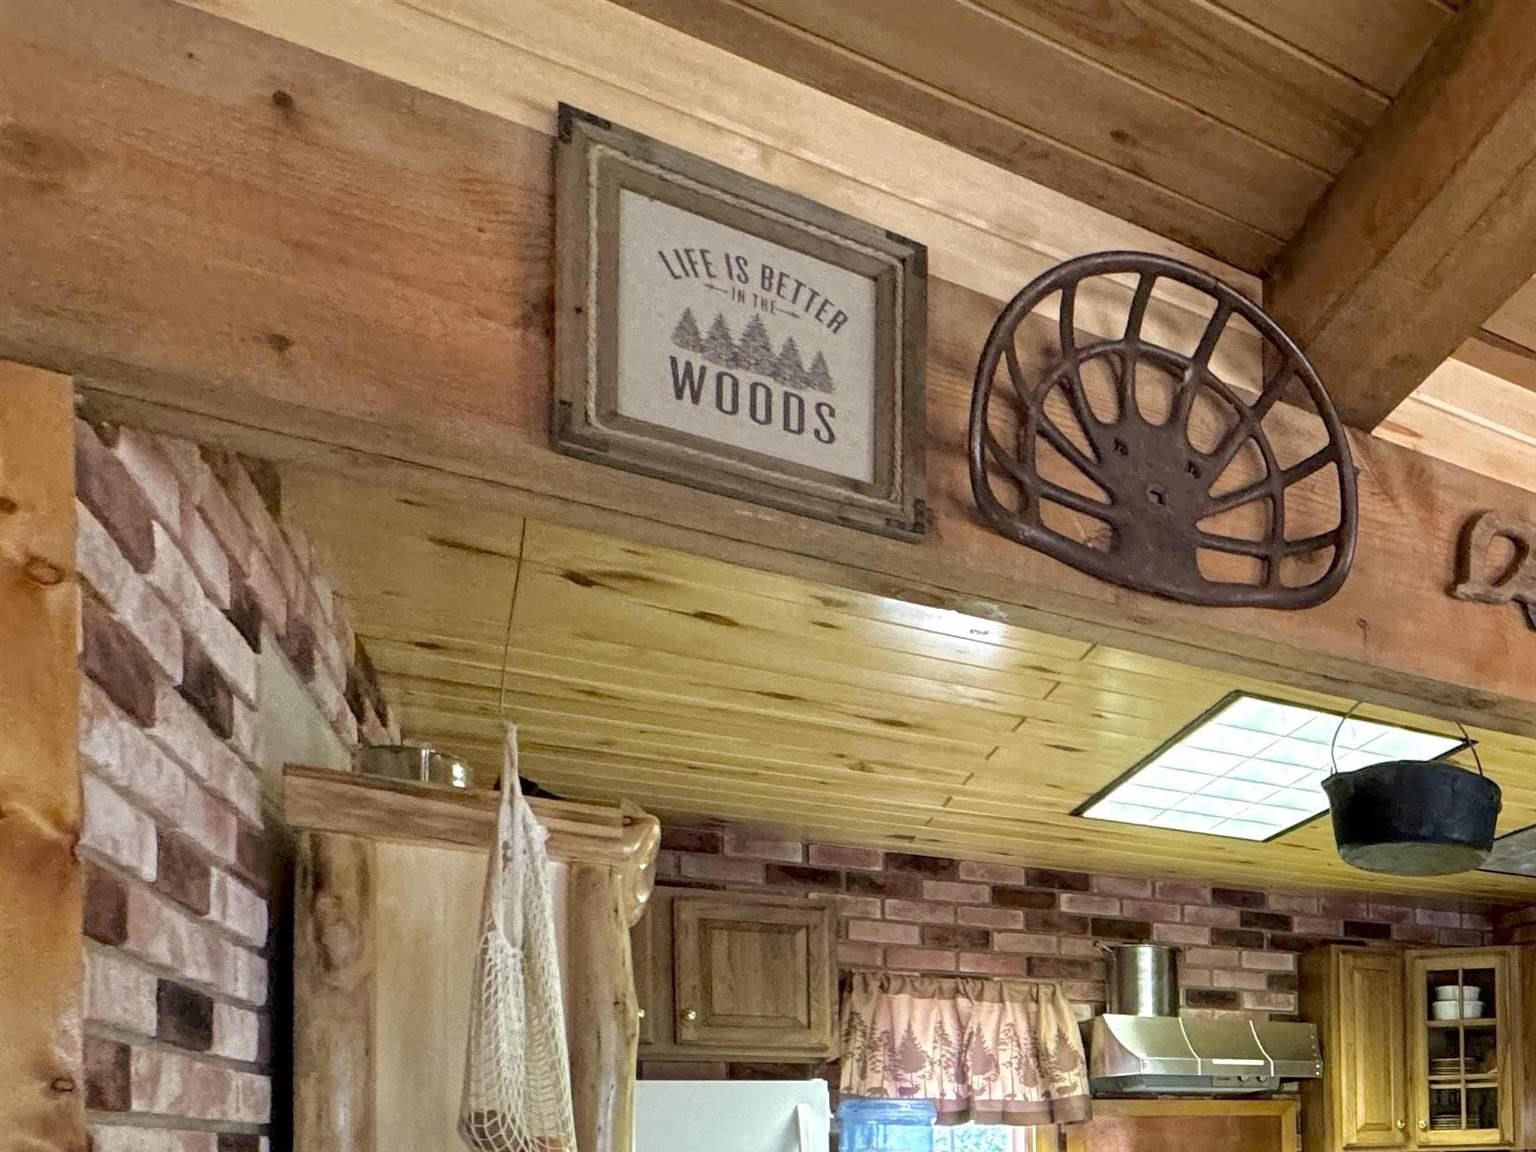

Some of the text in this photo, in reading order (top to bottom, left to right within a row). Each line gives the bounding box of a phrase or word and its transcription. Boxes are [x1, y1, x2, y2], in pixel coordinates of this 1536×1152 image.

[657, 248, 849, 335] LIFE IS BETTER
[730, 286, 777, 316] IN THE
[669, 355, 837, 445] WOODS
